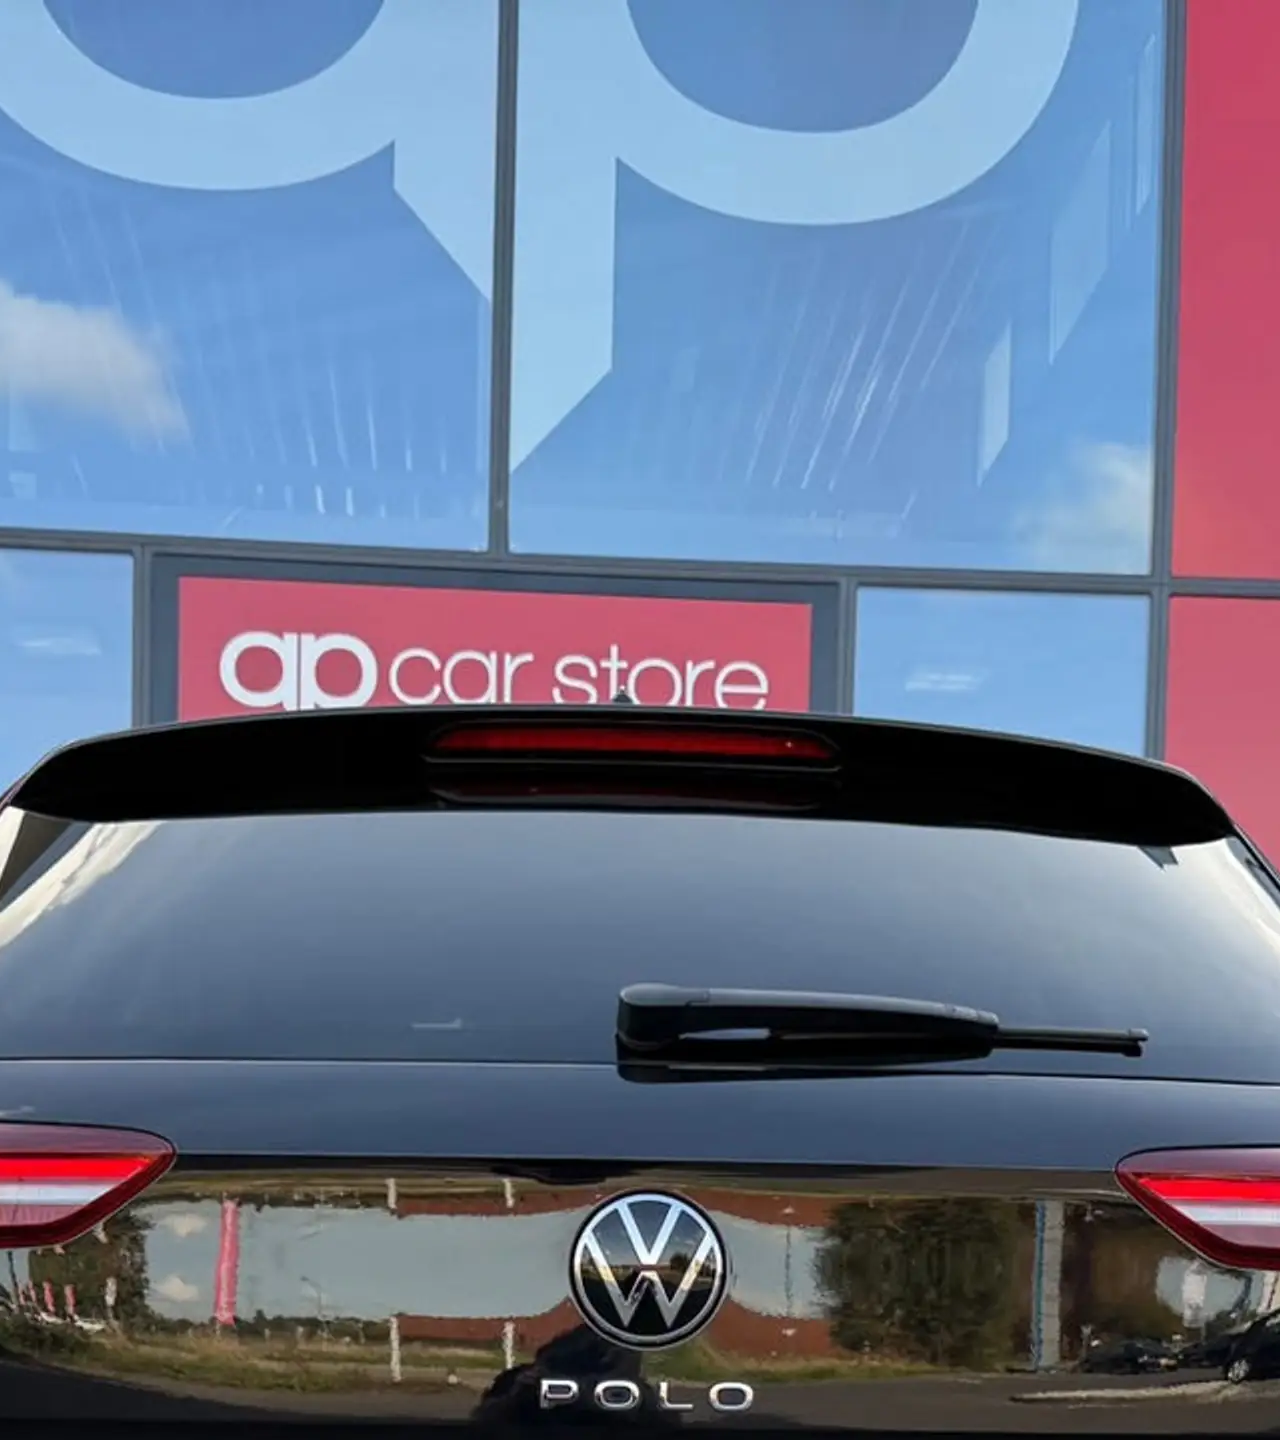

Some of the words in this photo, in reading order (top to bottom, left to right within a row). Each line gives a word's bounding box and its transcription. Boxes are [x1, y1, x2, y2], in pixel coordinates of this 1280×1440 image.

[220, 631, 378, 712] ap
[389, 647, 534, 706] car
[552, 644, 769, 711] store
[539, 1379, 755, 1412] POLO
